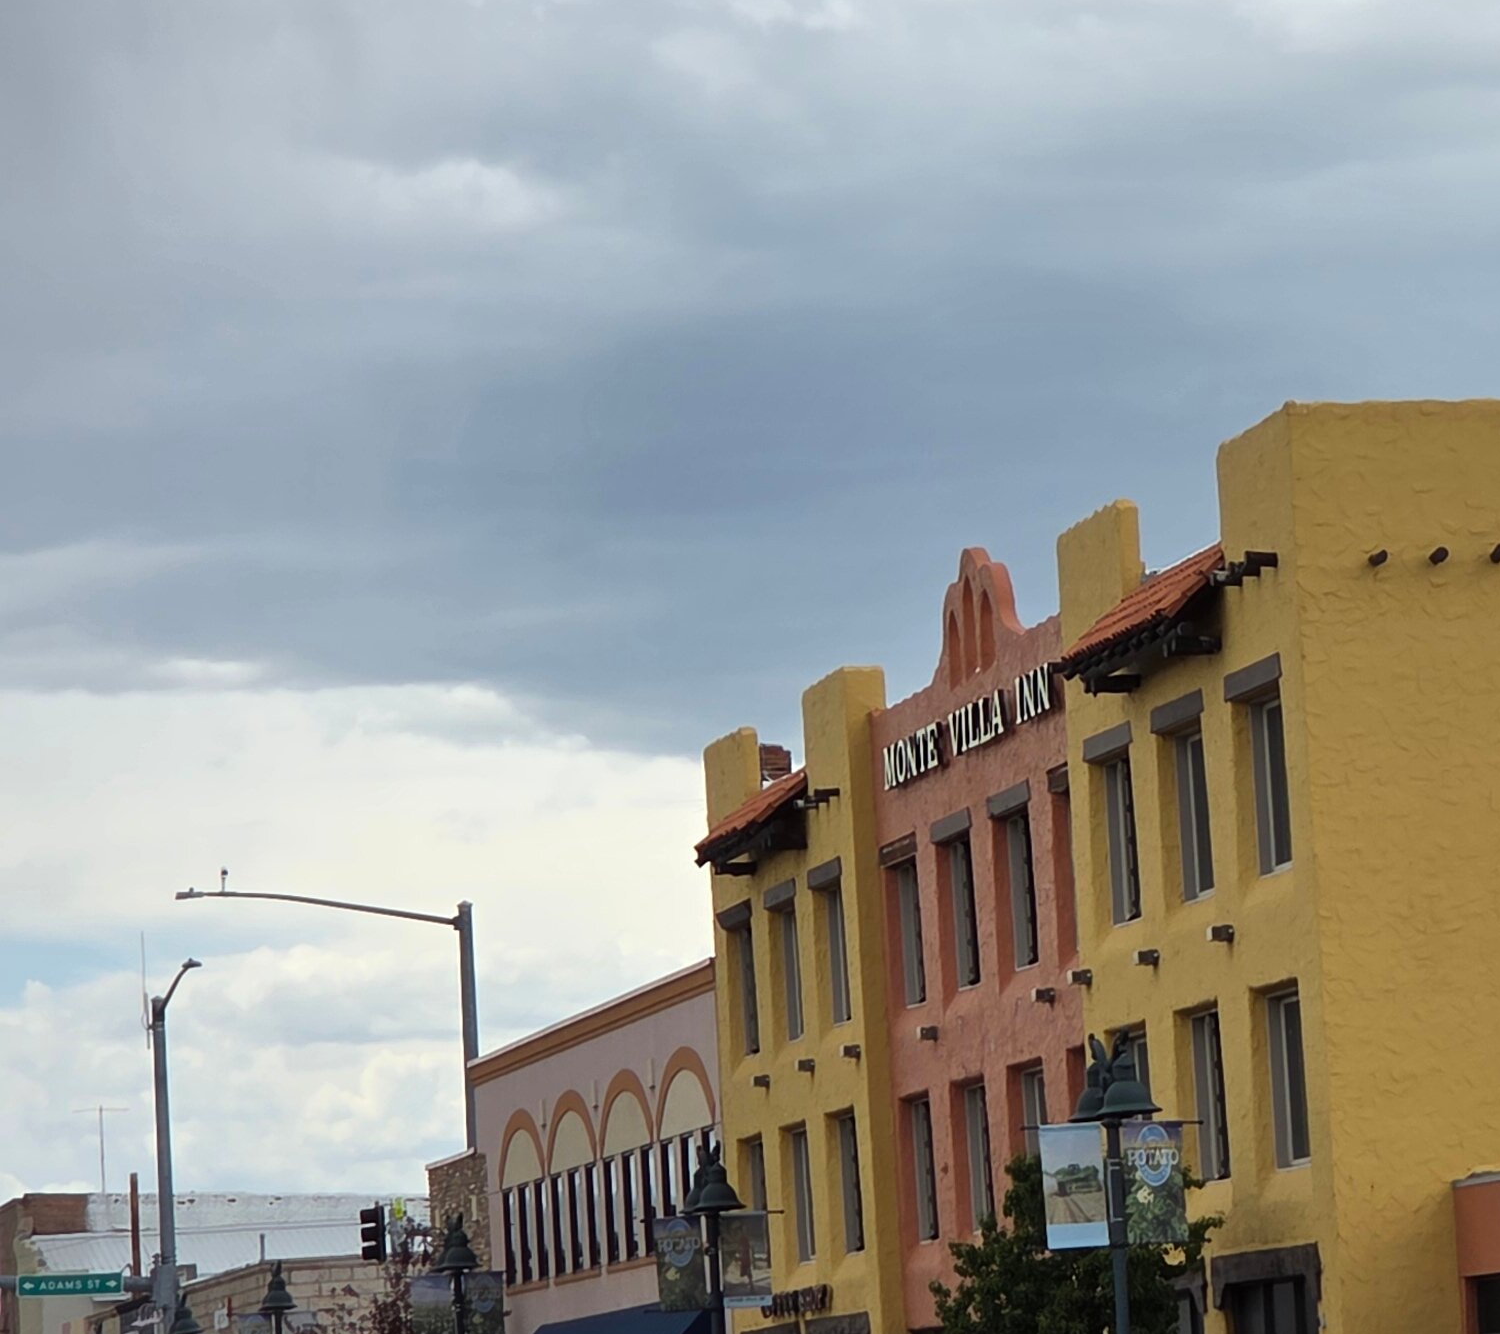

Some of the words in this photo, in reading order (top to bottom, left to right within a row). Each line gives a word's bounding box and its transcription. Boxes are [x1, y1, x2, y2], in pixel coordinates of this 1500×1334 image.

[882, 721, 939, 791] MONTE
[947, 688, 1005, 757] VILLA
[1014, 662, 1051, 725] INN
[1127, 1148, 1179, 1166] POTATO
[39, 1280, 82, 1291] ADAMS
[87, 1279, 100, 1289] ST
